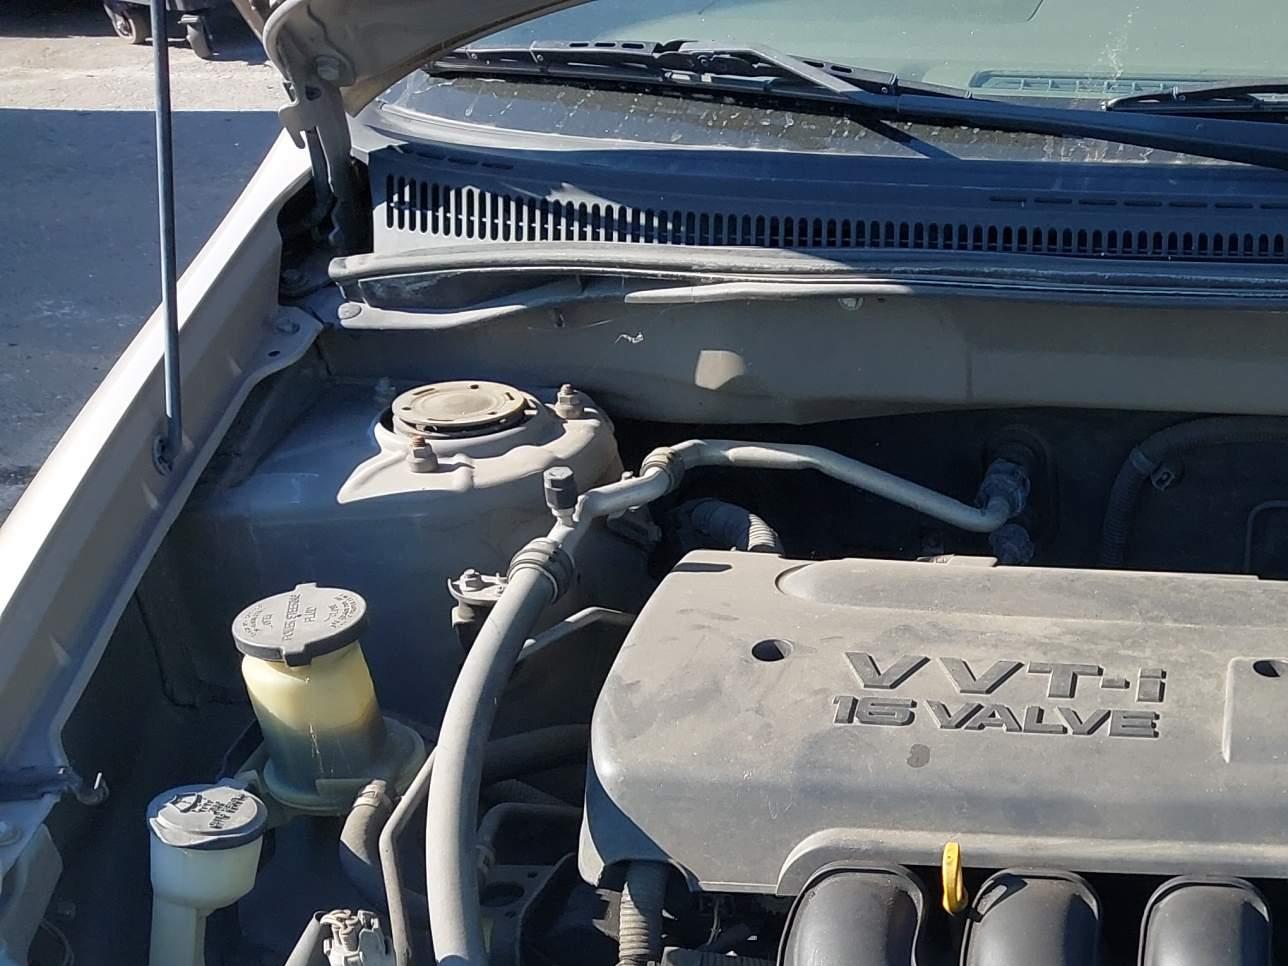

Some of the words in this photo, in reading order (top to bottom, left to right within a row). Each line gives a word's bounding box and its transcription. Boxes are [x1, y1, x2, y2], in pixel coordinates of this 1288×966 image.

[844, 651, 1168, 703] VVT-i
[832, 695, 918, 727] 16
[923, 699, 1161, 739] VALVE
